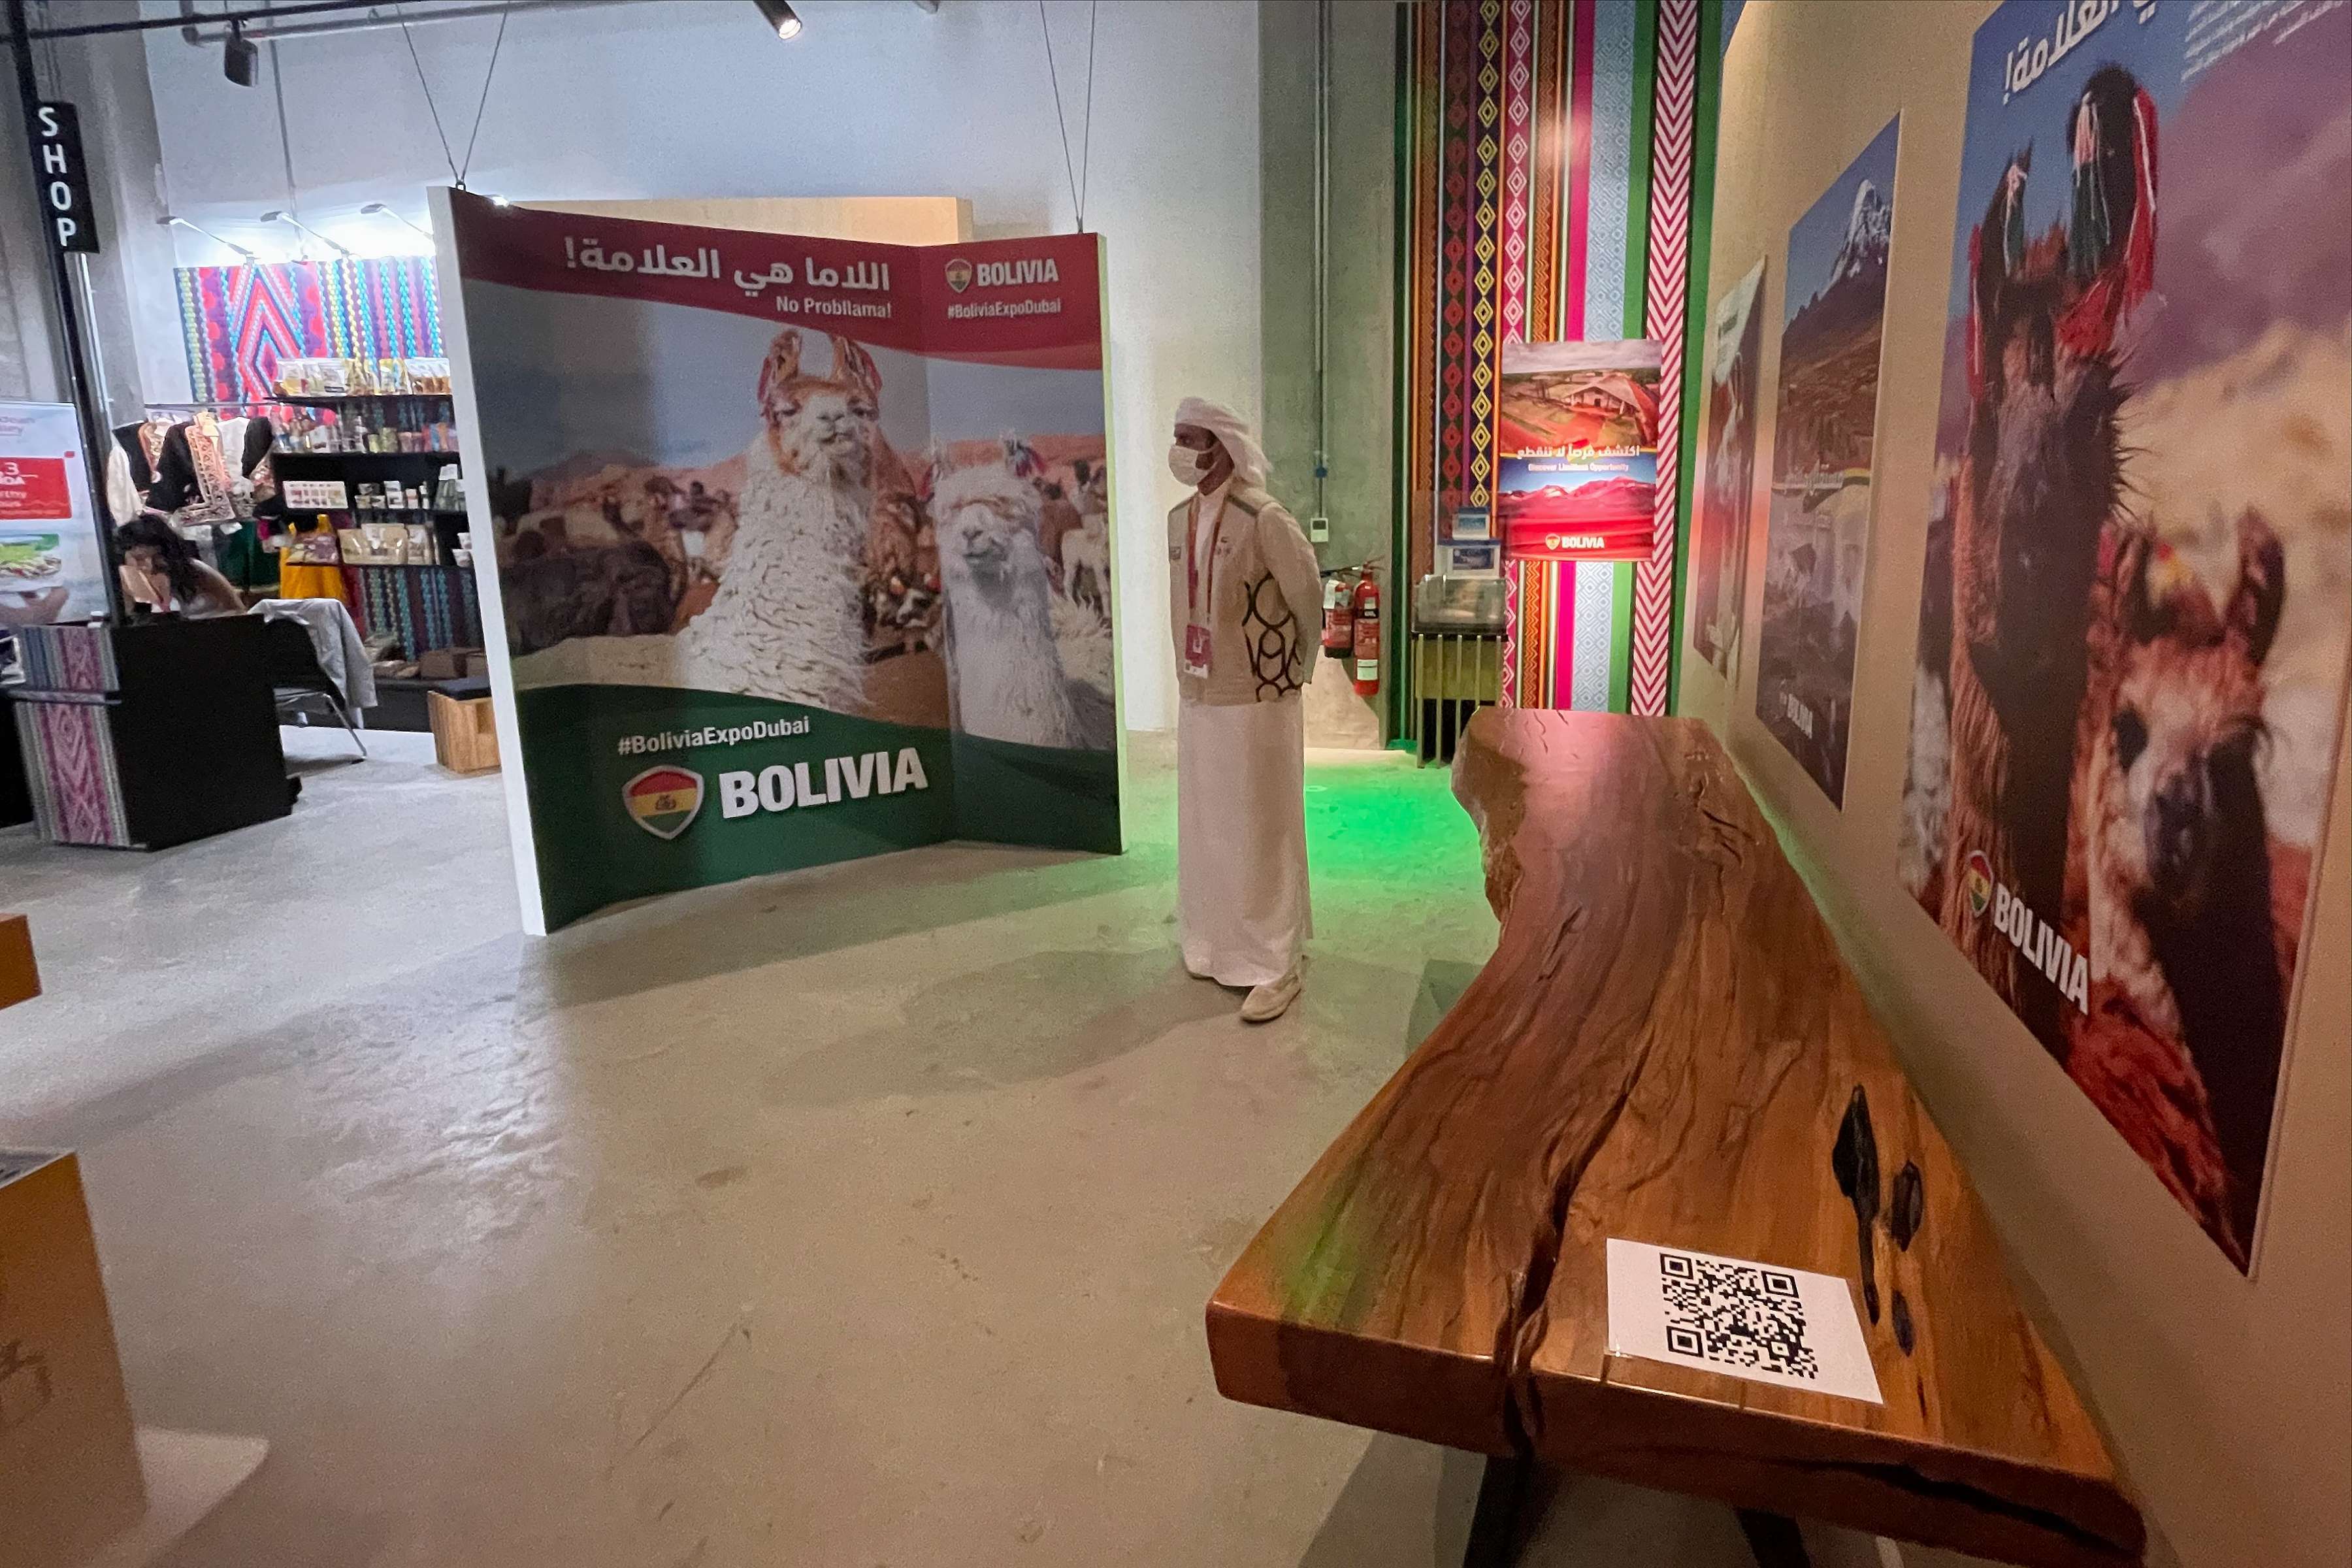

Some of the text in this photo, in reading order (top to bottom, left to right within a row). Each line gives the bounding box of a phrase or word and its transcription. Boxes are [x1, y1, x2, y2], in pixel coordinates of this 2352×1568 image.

[38, 106, 77, 246] SHOP
[564, 237, 889, 297] اللاما هي العلامة!
[977, 258, 1059, 287] BOLIVIA
[776, 296, 891, 318] No Probllama!
[947, 297, 1061, 319] #BoliviaExpoDubai
[1561, 536, 1605, 549] BOLIVIA
[617, 715, 809, 755] #BoliviaExpoDubai
[719, 747, 928, 819] BOLIVIA
[1994, 882, 2088, 1016] BOLIVIA
